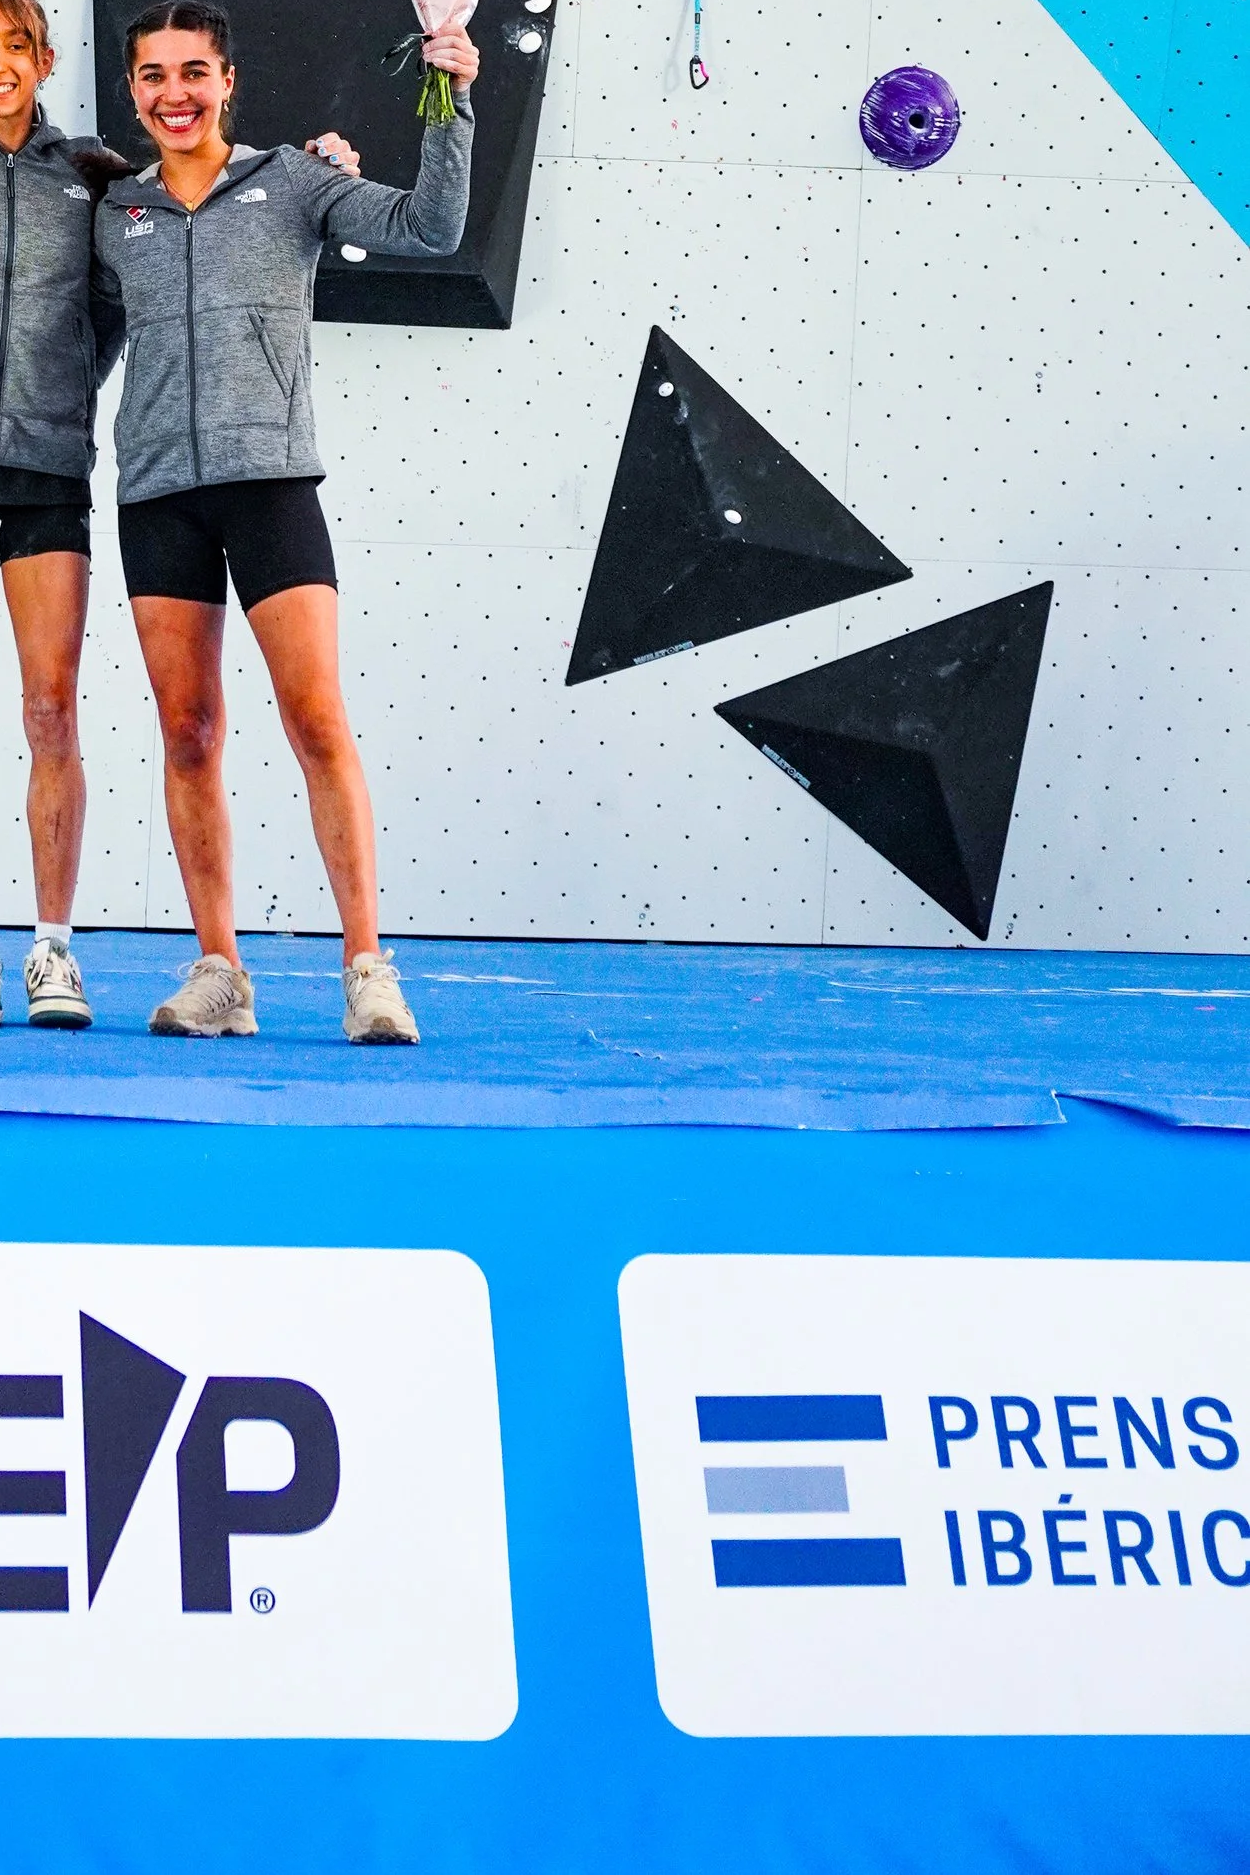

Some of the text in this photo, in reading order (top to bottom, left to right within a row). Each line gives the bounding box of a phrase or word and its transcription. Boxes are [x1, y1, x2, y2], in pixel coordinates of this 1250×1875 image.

[125, 221, 154, 236] USA
[929, 1396, 1239, 1470] PRENS
[945, 1494, 1250, 1587] IBÉRIC
